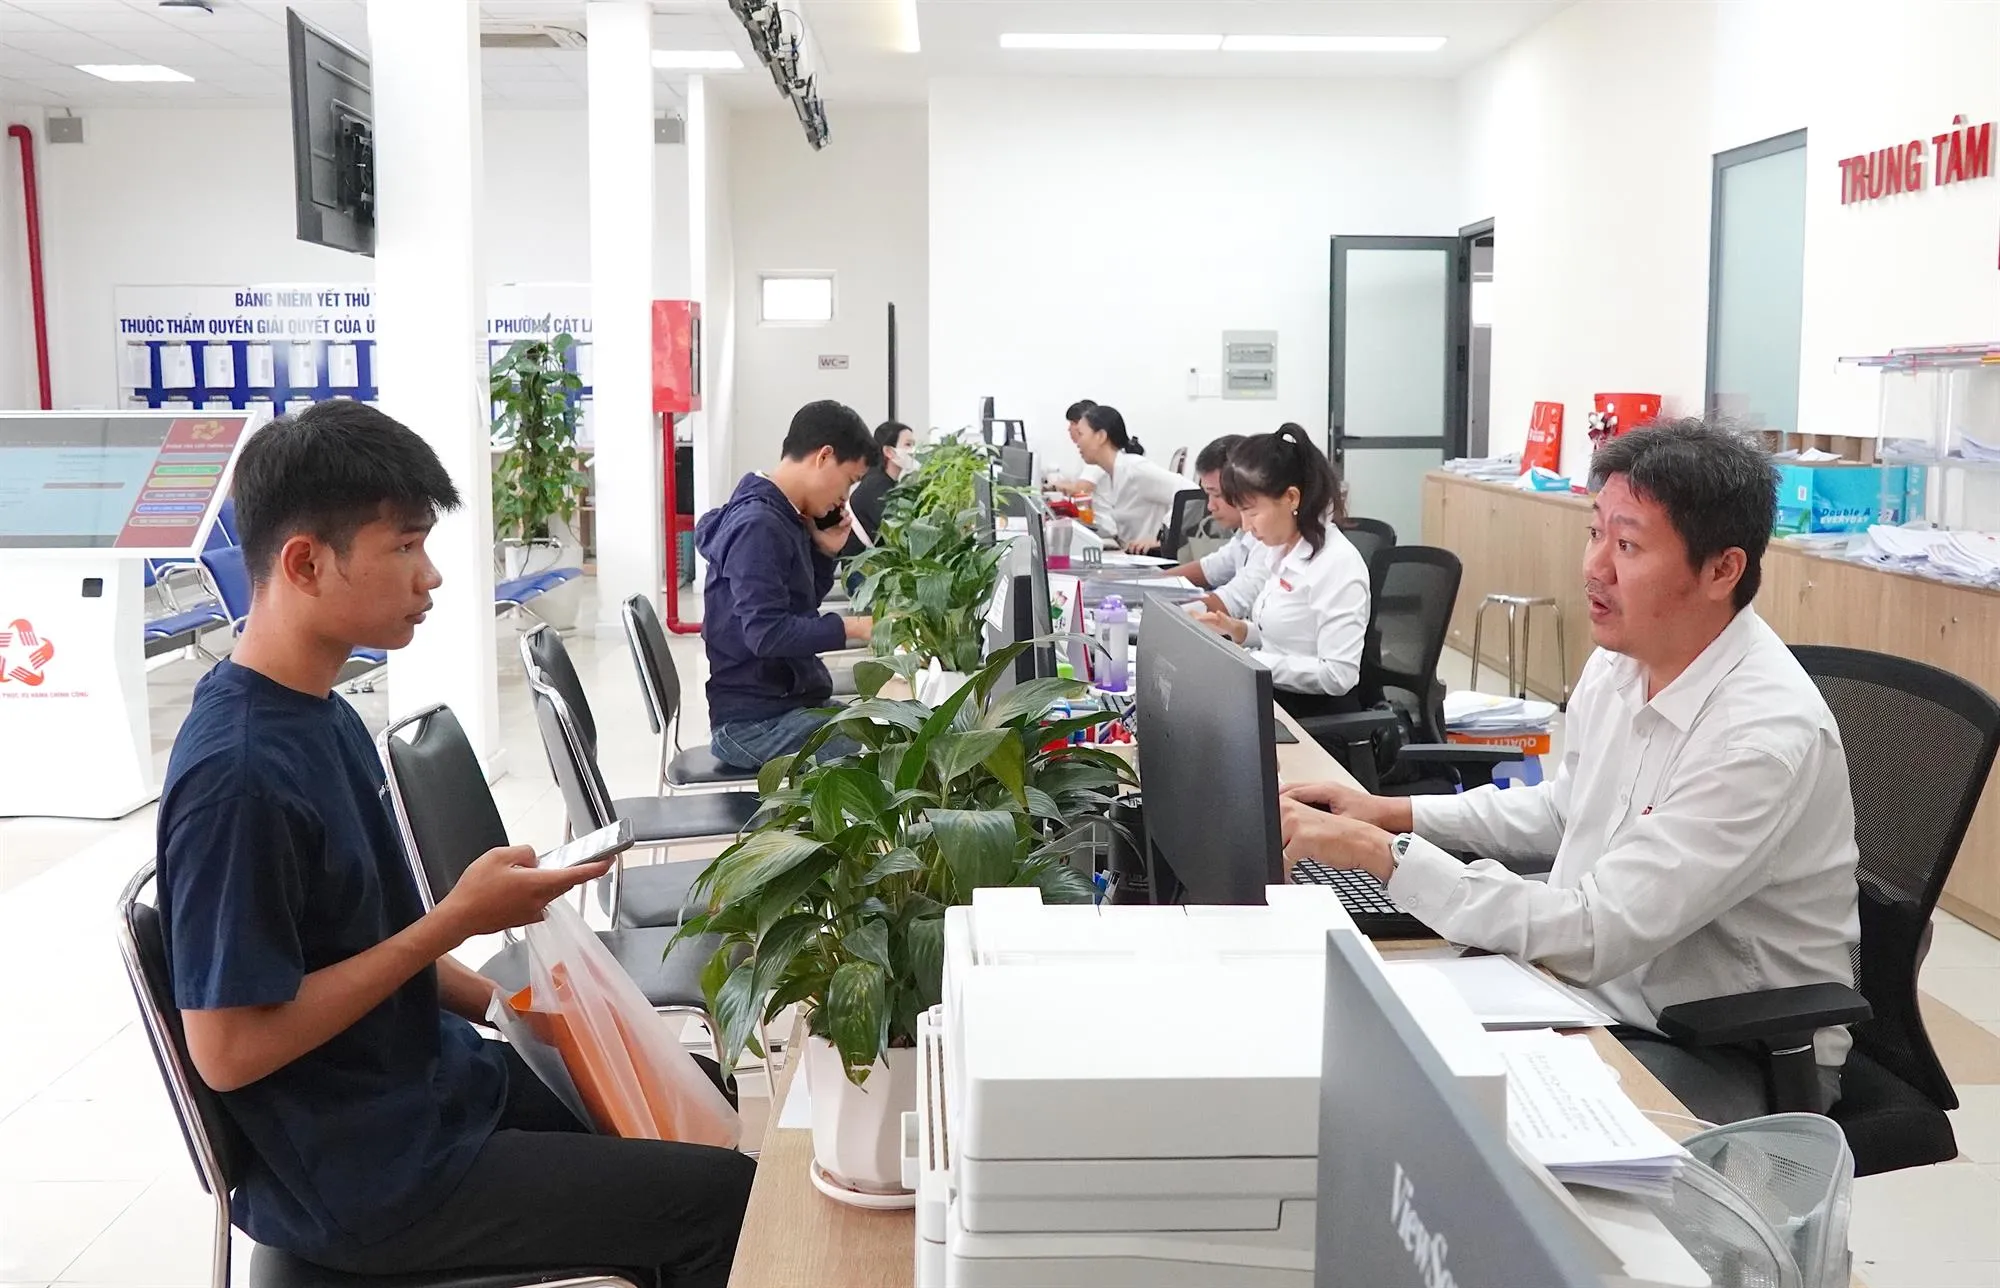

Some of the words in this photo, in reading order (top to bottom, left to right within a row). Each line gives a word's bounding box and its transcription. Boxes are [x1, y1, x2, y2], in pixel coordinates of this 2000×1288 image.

[1838, 140, 1922, 205] TRUNG
[1932, 114, 1990, 186] TÂM
[235, 287, 272, 307] BẢNG
[317, 287, 340, 307] YẾT
[344, 287, 370, 307] THỦ
[120, 315, 164, 337] THUỘC
[166, 312, 204, 334] THẨM
[257, 314, 284, 334] GIẢI
[288, 314, 330, 335] QUYẾT
[334, 313, 361, 334] CỦA
[553, 314, 579, 333] CÁT
[1821, 507, 1860, 517] Double
[1863, 507, 1871, 517] A
